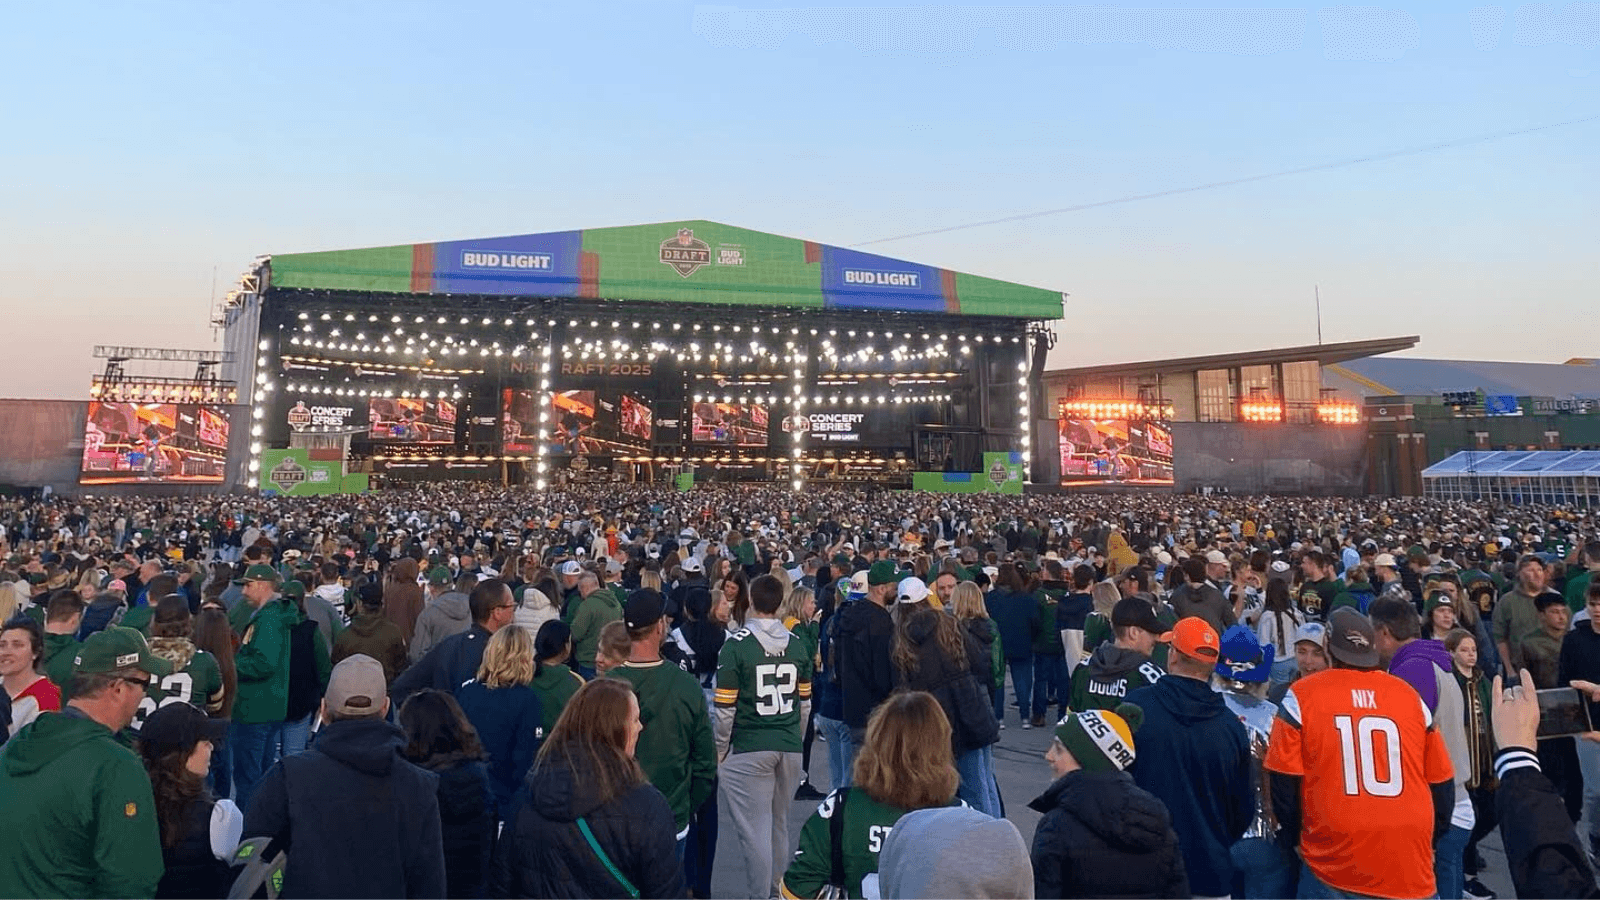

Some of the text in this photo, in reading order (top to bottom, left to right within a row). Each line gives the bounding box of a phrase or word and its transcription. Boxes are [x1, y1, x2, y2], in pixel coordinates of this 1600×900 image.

[664, 250, 707, 260] DRAFT
[720, 250, 741, 258] BUD
[464, 252, 551, 269] BUD LIGHT
[717, 256, 743, 265] LIGHT
[845, 270, 918, 286] BUD LIGHT
[561, 363, 605, 375] RAFT
[610, 364, 652, 375] 2025
[310, 405, 354, 417] CONCERT
[1534, 400, 1592, 411] TAILGATE
[311, 415, 344, 426] SERIES
[809, 413, 865, 423] CONCERT
[812, 422, 853, 432] SERIES
[273, 472, 304, 481] DRAFT
[1556, 544, 1565, 557] 5
[756, 663, 798, 716] 52
[1351, 689, 1378, 709] NIX
[1333, 714, 1404, 797] 10
